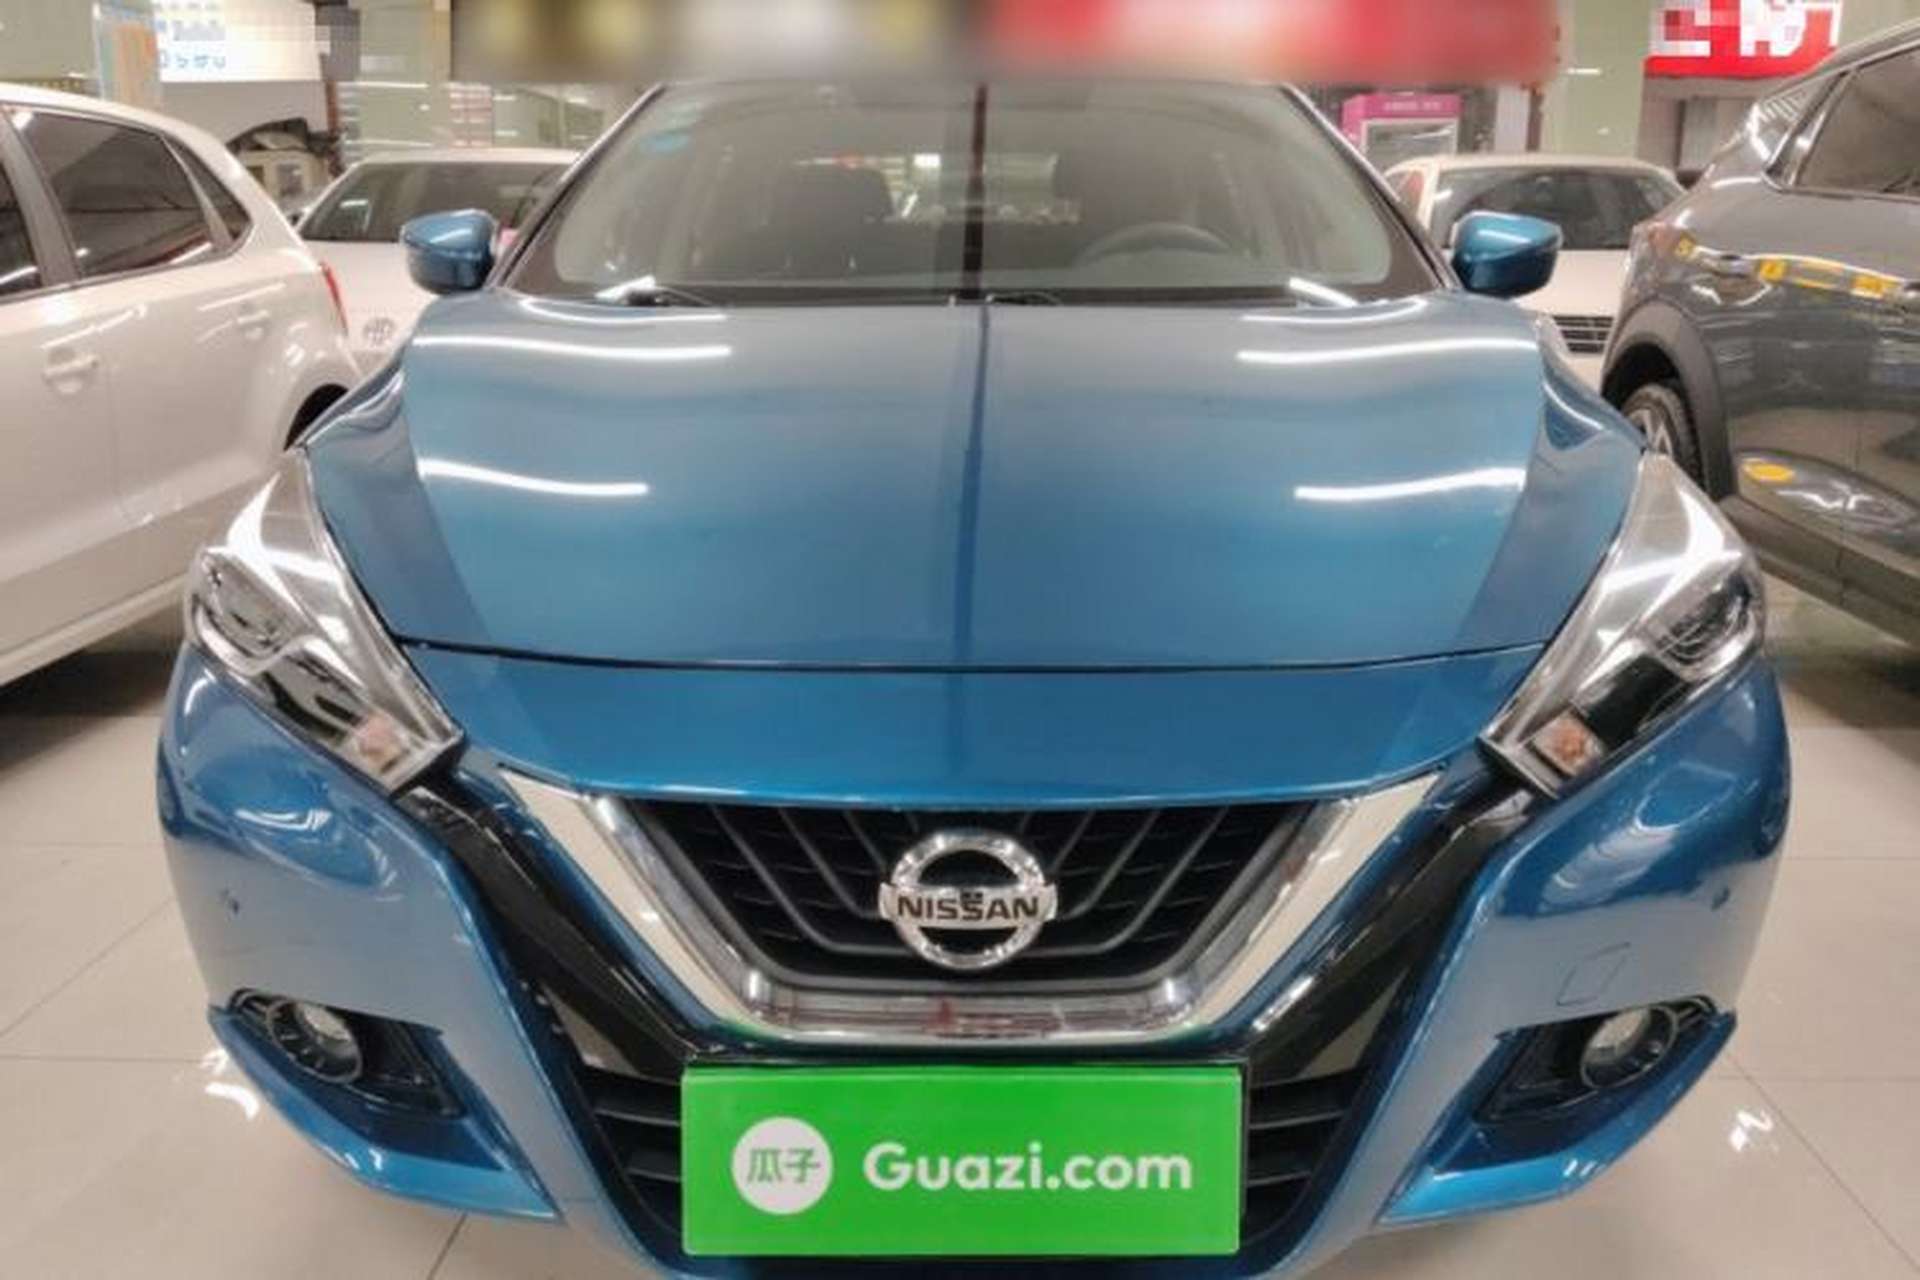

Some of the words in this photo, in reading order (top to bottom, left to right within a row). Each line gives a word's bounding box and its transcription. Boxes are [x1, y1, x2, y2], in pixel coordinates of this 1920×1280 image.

[897, 896, 1040, 922] NISSAN
[746, 1147, 821, 1184] 瓜子
[863, 1141, 1193, 1191] Guazi.com
